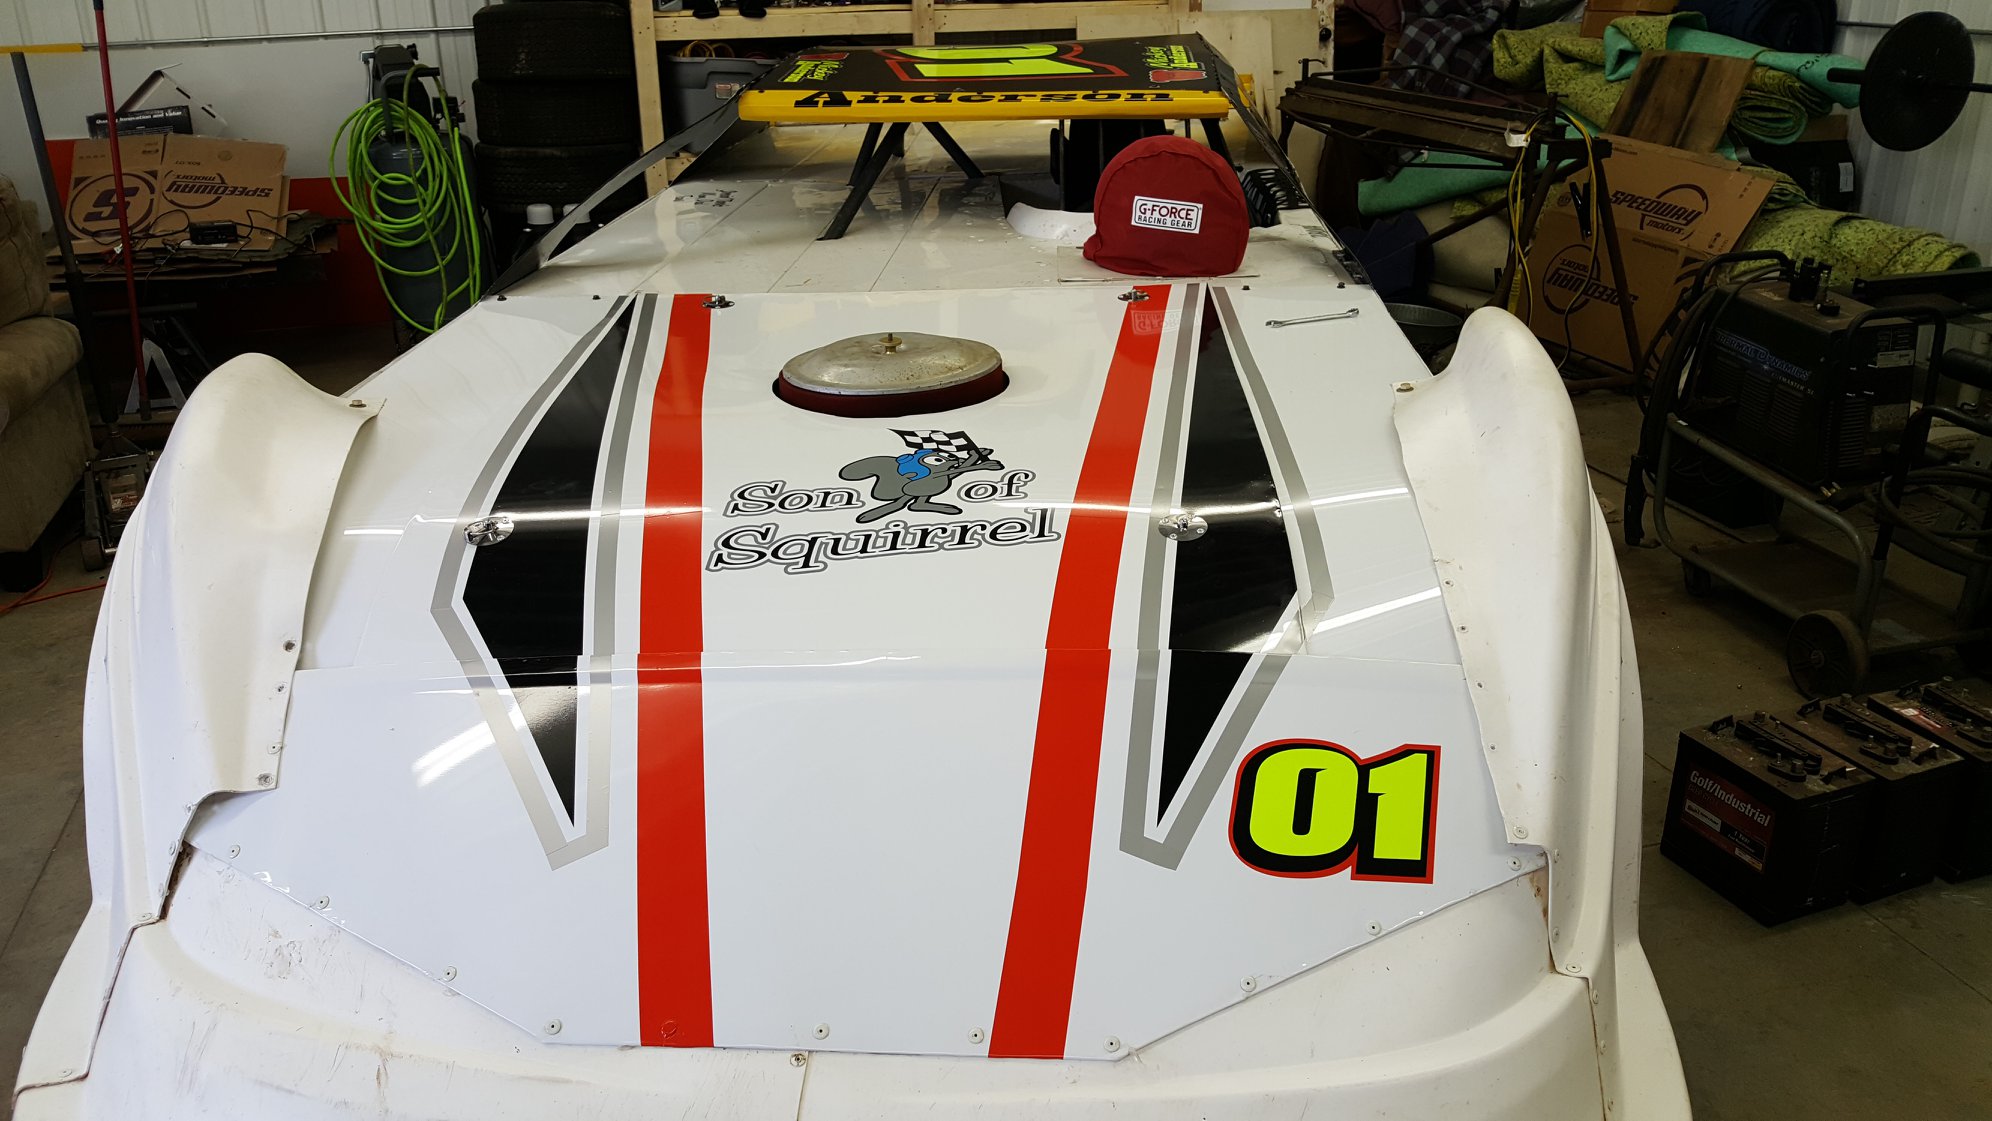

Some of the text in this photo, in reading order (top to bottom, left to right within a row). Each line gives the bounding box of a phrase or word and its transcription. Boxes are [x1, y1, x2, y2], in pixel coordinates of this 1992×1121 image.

[794, 90, 1174, 108] Anderson
[165, 182, 274, 198] SPEEDWAY
[1611, 190, 1703, 226] SPEEDWAY
[1137, 214, 1193, 229] RACING GEAR
[726, 470, 1035, 514] Son of
[708, 507, 1060, 573] Squirrel
[1236, 743, 1433, 876] 01
[1689, 770, 1772, 827] Golf/Industrial
